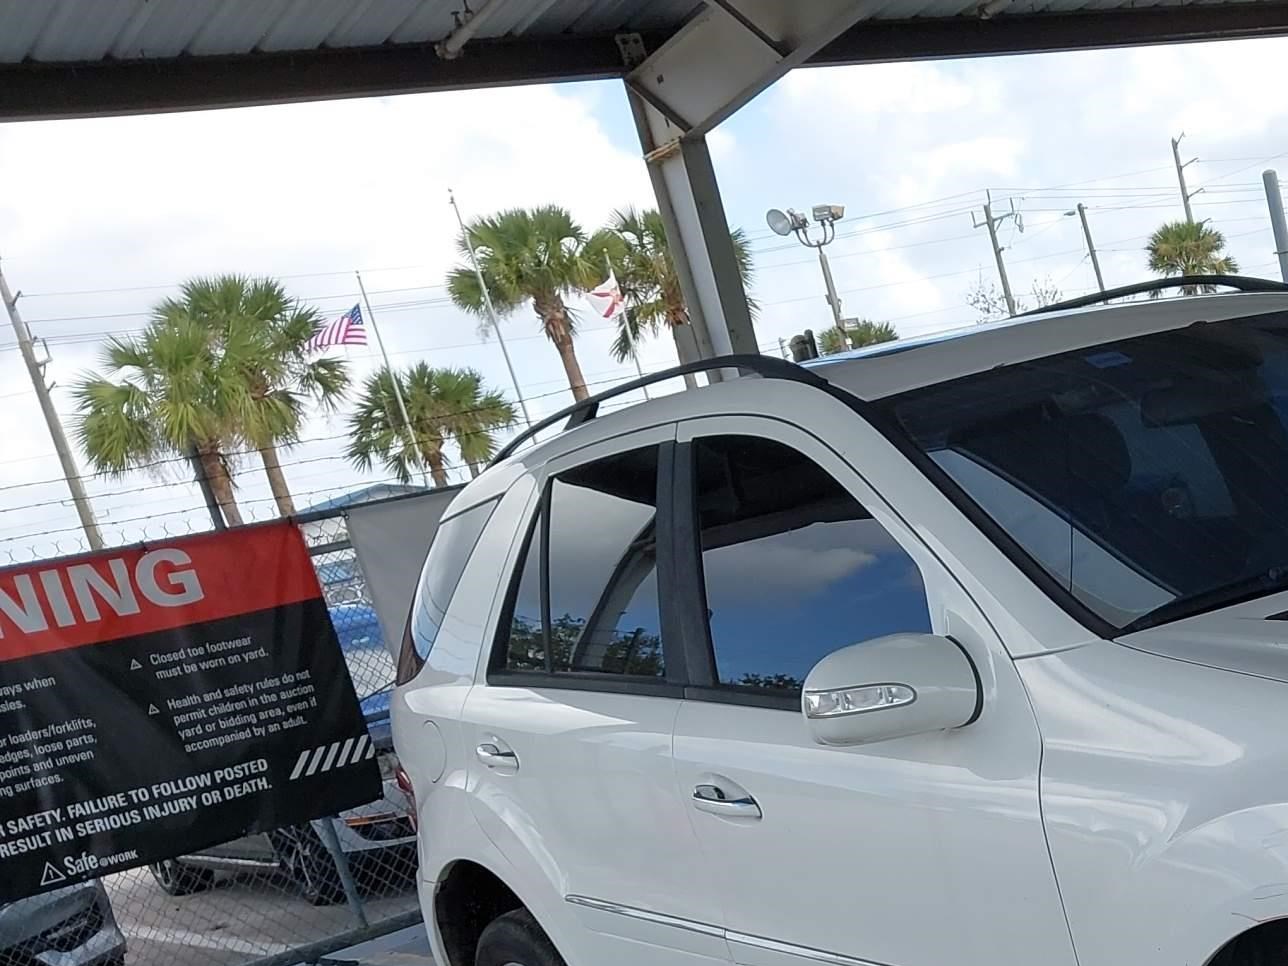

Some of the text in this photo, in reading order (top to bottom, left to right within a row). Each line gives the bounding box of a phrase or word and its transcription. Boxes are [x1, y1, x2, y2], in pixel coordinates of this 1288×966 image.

[150, 636, 252, 666] Closed toe footwear
[156, 647, 269, 680] must be worn on yard.
[23, 676, 56, 691] when
[167, 669, 311, 711] Health and safety rules do not
[174, 684, 315, 726] permit children in the auction
[178, 696, 318, 741] yard or bidding area, even if
[0, 732, 97, 763] edges, loose parts,
[8, 718, 97, 745] loaders/forklifts,
[184, 715, 307, 753] accompanied by an adult.
[0, 750, 95, 783] points and uneven
[14, 773, 64, 793] surfaces.
[6, 808, 66, 835] SAFETY.
[67, 792, 128, 819] FAILURE
[127, 787, 150, 804] TO
[151, 772, 212, 799] FOLLOW
[213, 758, 268, 784] POSTED
[0, 776, 273, 858] RESULT IN SERIOUS INJURY OR DEATH.
